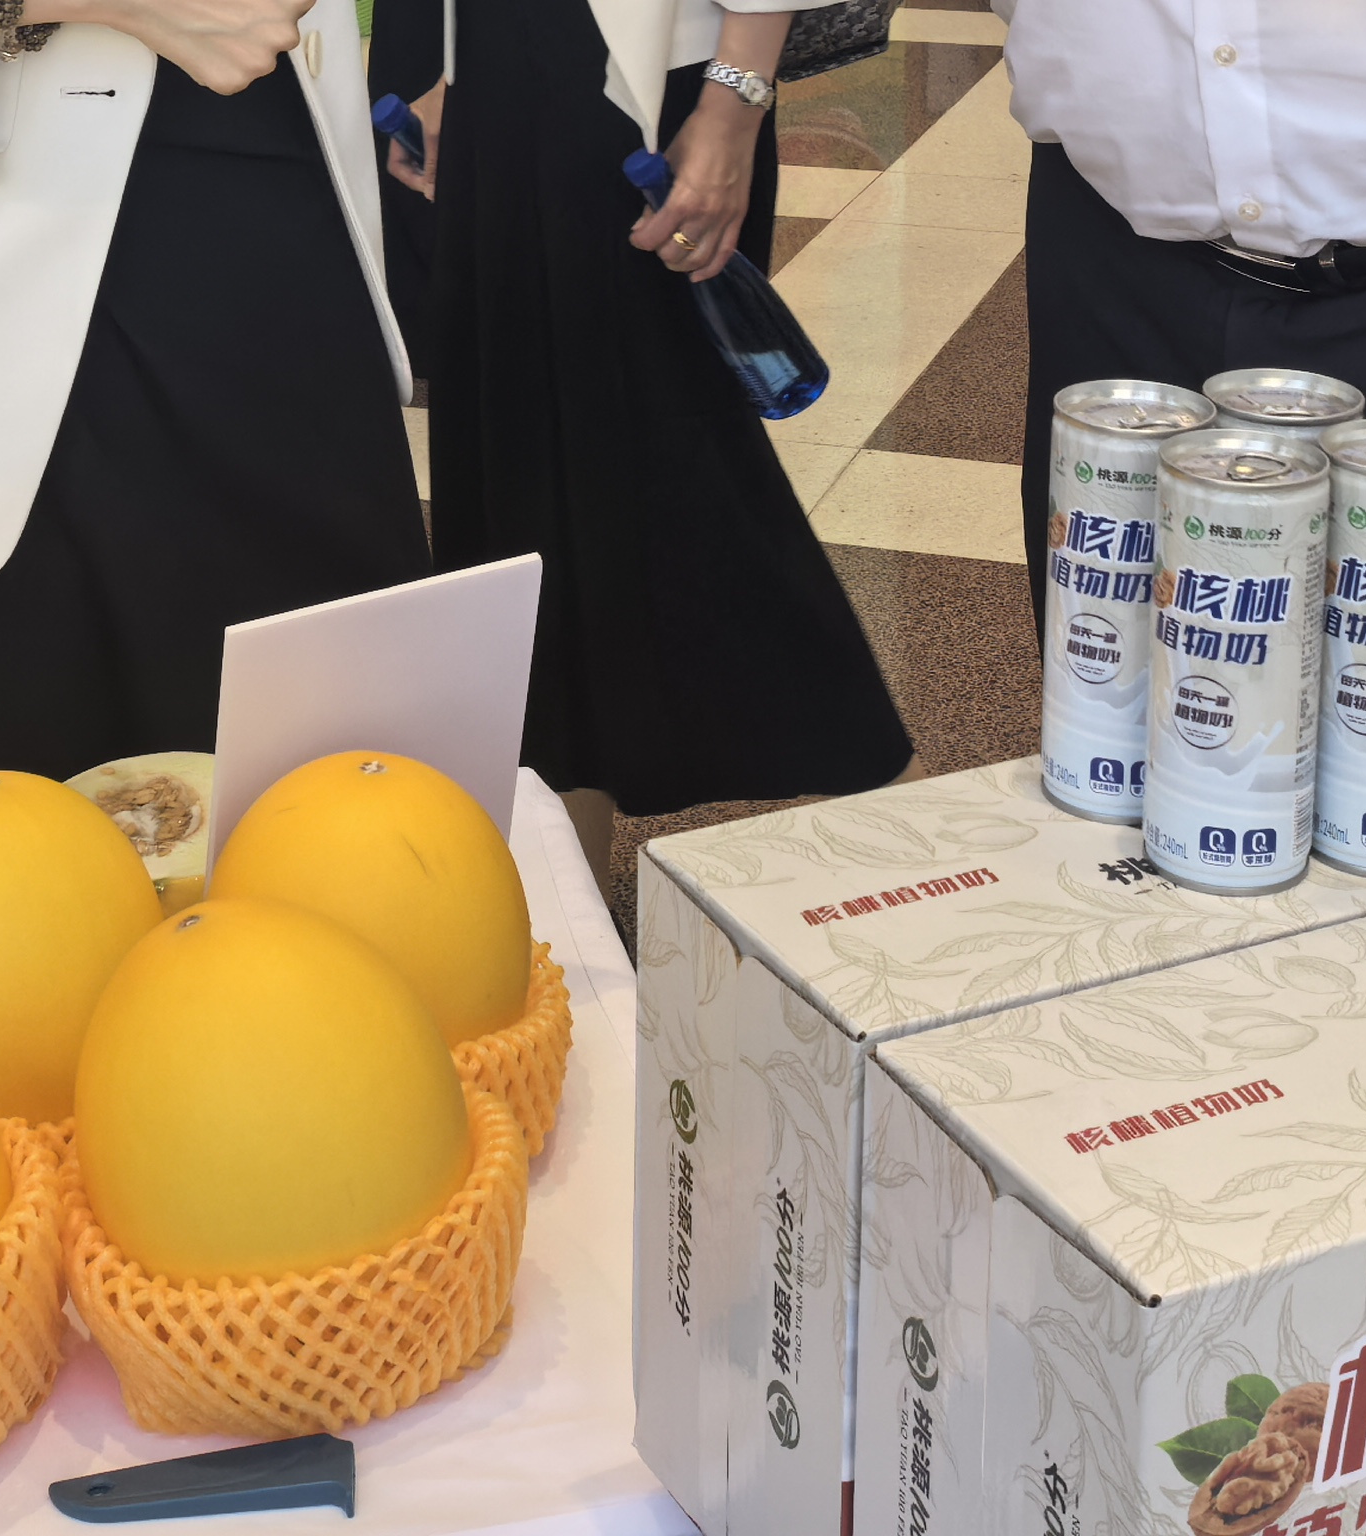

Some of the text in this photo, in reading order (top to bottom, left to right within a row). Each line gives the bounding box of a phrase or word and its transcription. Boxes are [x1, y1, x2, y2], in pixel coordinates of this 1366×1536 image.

[1096, 467, 1158, 485] 桃源100
[1066, 510, 1155, 563] 核桃
[1208, 524, 1282, 541] 桃源100分
[1050, 552, 1153, 604] 植物奶
[1174, 568, 1291, 623] 核桃
[1156, 611, 1268, 665] 植物奶
[800, 867, 1000, 927] 核桃植物奶
[1063, 1077, 1285, 1154] 核桃植物奶
